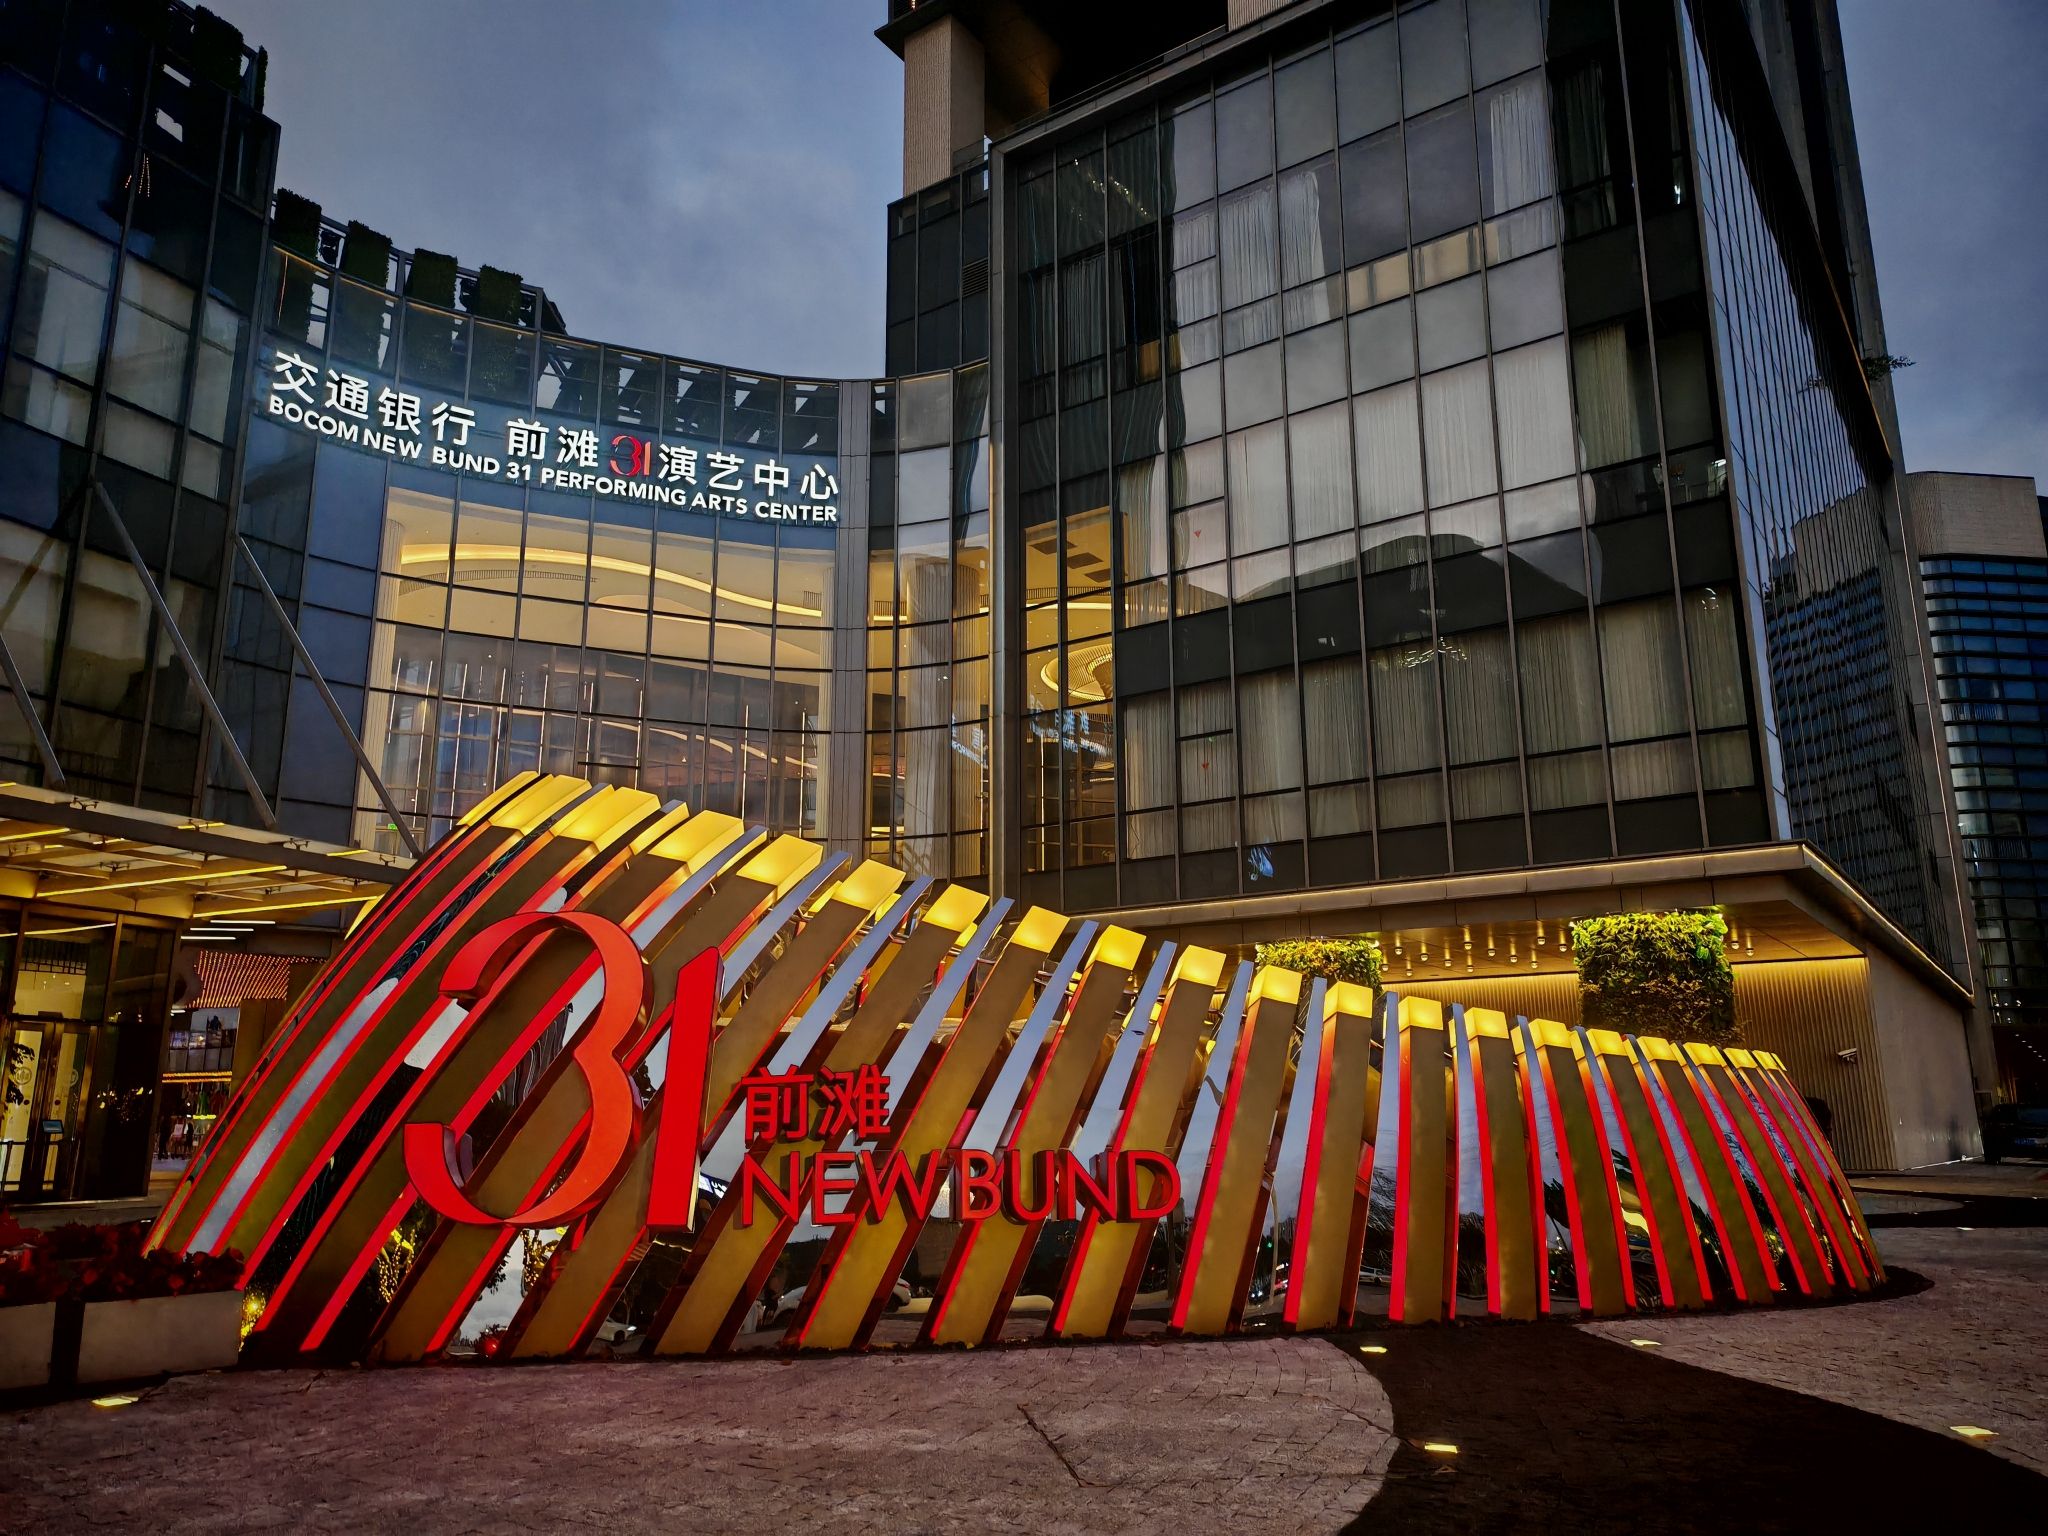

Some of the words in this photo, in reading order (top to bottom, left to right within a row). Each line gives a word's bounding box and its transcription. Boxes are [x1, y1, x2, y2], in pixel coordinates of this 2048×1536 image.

[272, 350, 476, 446] 交通银行
[269, 394, 359, 443] BOCOM
[363, 430, 423, 459] NEW
[432, 446, 500, 475] BUND
[506, 461, 531, 481] 31
[541, 467, 686, 506] PERFORMING
[691, 492, 748, 516] ARTS
[755, 501, 837, 522] CENTER
[403, 911, 724, 1232] 31
[741, 1064, 891, 1140] 前滩
[742, 1150, 941, 1226] NEW
[961, 1149, 1182, 1221] BUND
